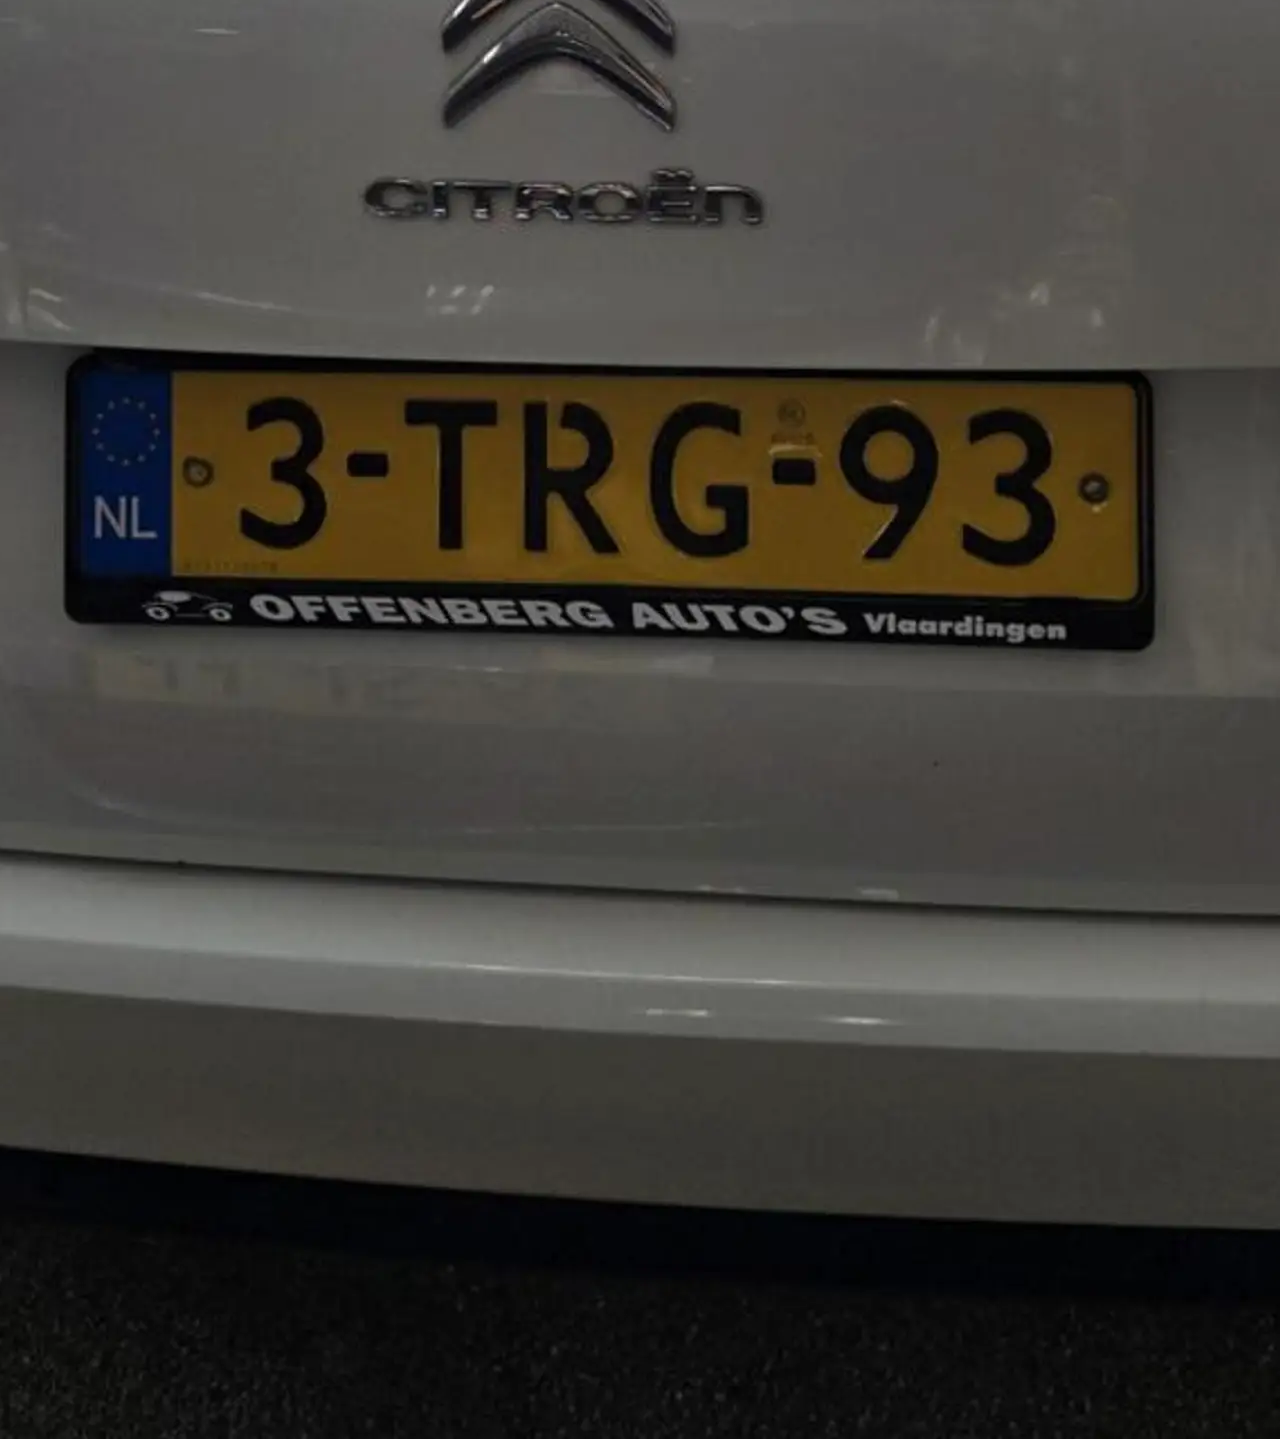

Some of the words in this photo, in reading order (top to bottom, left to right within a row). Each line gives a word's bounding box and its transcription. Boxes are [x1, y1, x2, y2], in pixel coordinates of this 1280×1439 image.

[239, 396, 1058, 567] 3-TRG-93
[93, 496, 157, 541] NL
[249, 592, 614, 630] OFFENBERG
[632, 602, 848, 636] AUTO'S
[863, 612, 1068, 643] Vlaardingen
